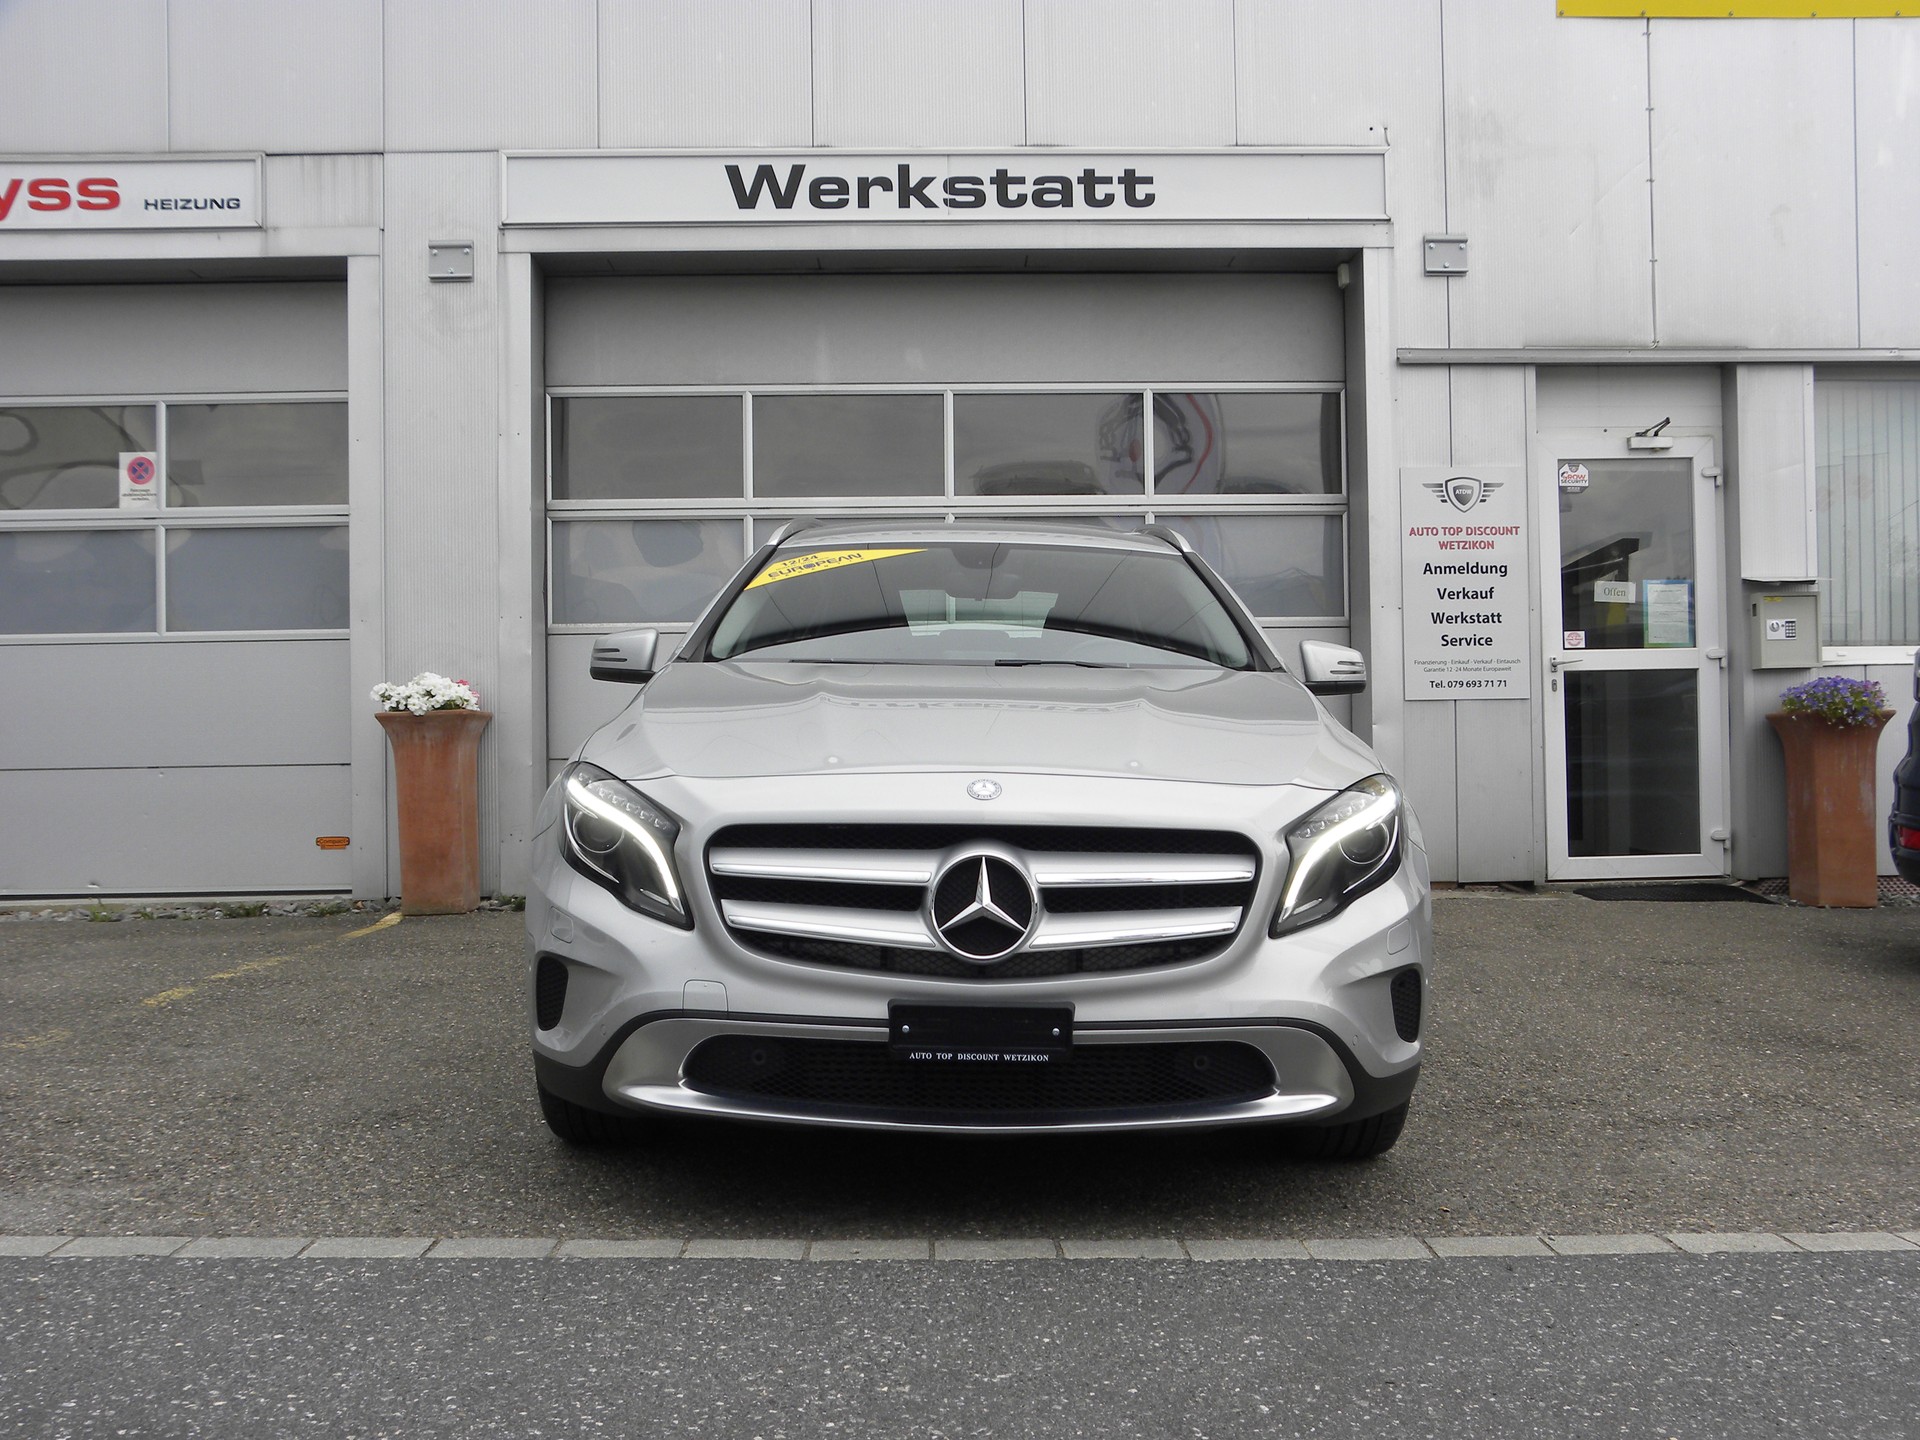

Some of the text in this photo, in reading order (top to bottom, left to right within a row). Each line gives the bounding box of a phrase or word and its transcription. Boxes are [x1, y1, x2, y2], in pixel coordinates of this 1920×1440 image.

[724, 164, 1156, 209] Werkstatt
[144, 198, 241, 210] HEIZUNG
[1409, 526, 1520, 536] AUTO TOP DISCOUNT
[1439, 541, 1495, 550] WETZIKON
[781, 555, 818, 566] 12/24
[1423, 562, 1508, 577] Anmeldung
[1437, 587, 1495, 600] Verkauf
[1603, 587, 1626, 597] Offen
[1431, 612, 1502, 624] Werkstatt
[1441, 634, 1493, 646] Service
[1430, 680, 1446, 688] Tel.
[1447, 680, 1464, 688] 079
[1465, 680, 1482, 688] 693
[909, 1052, 1049, 1062] AUTO TOP DISCOUNT WETZIKON
